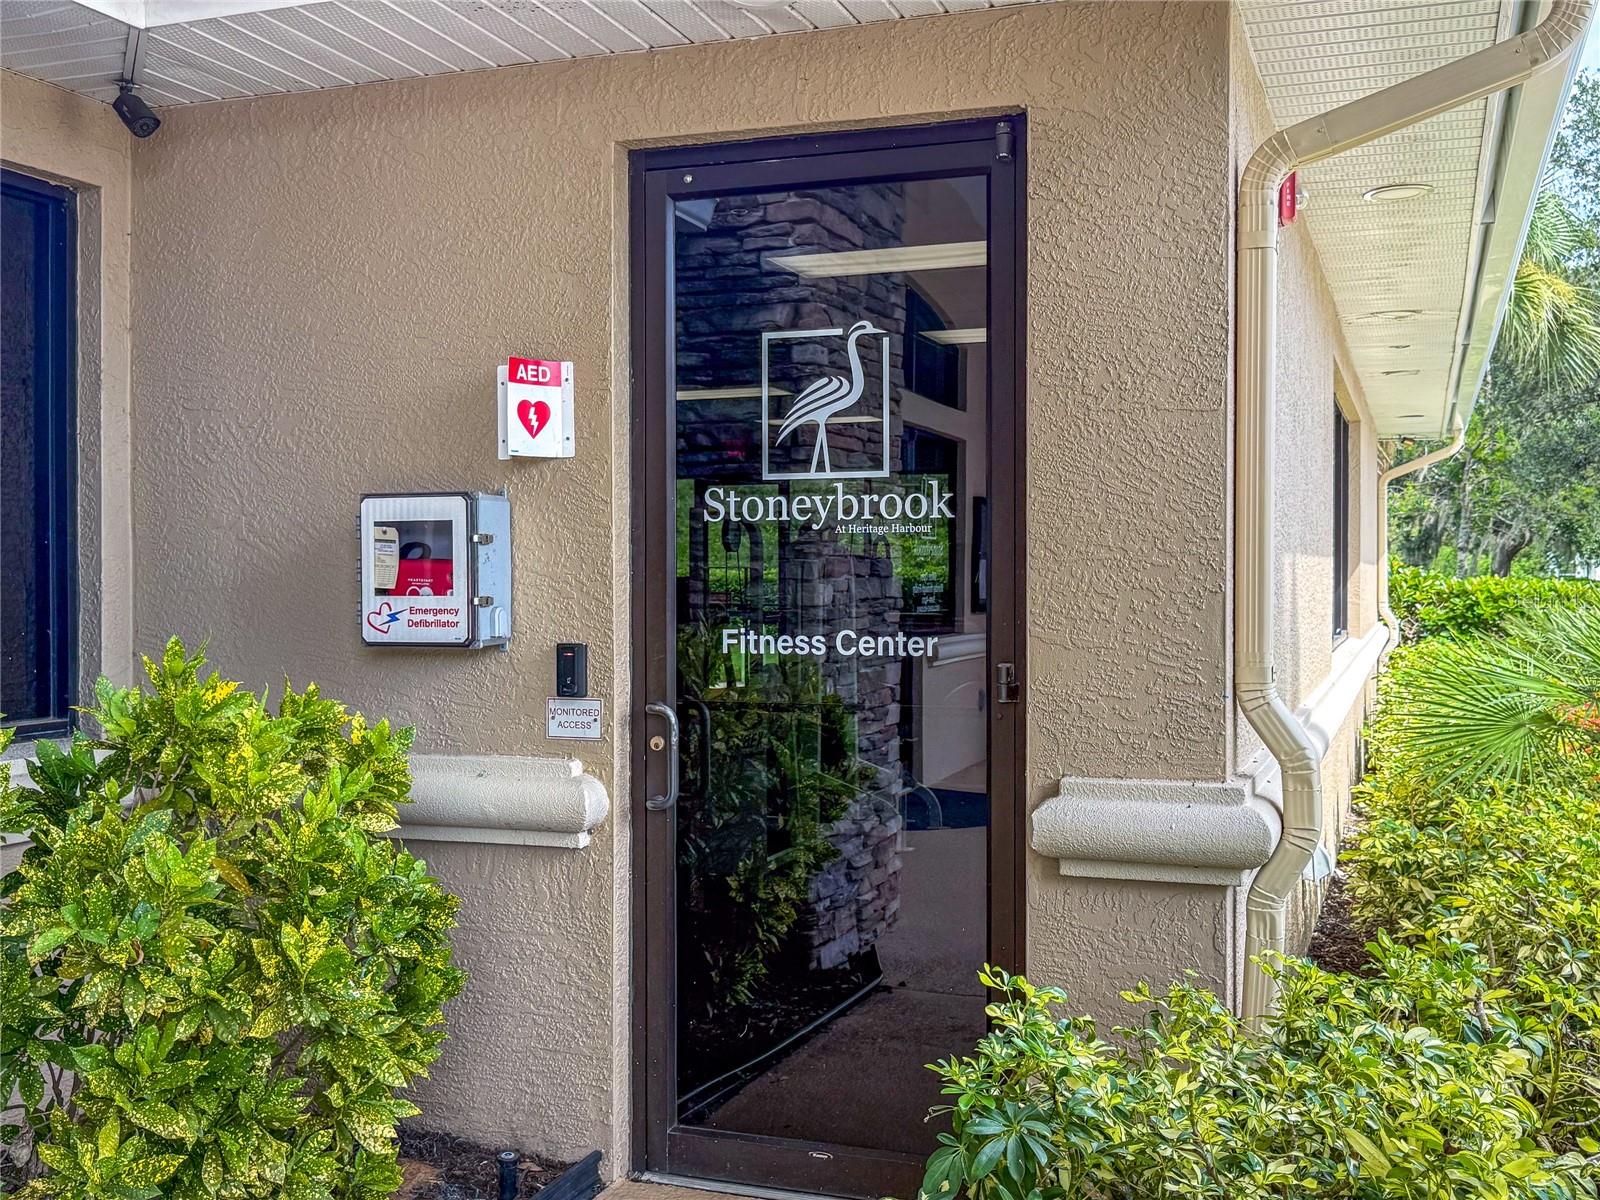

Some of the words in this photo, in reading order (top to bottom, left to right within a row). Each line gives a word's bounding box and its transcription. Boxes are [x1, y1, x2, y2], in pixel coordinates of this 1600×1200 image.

[516, 363, 551, 383] AED
[703, 480, 955, 530] Stoneybrook
[835, 524, 846, 534] At
[848, 523, 889, 536] Heritage
[891, 522, 933, 533] Harbour
[409, 606, 459, 616] Emergency
[407, 619, 460, 628] Defibrillator
[722, 628, 827, 656] Fitness
[835, 629, 939, 657] Center
[549, 707, 600, 717] MONITORED
[557, 720, 592, 730] ACCESS
